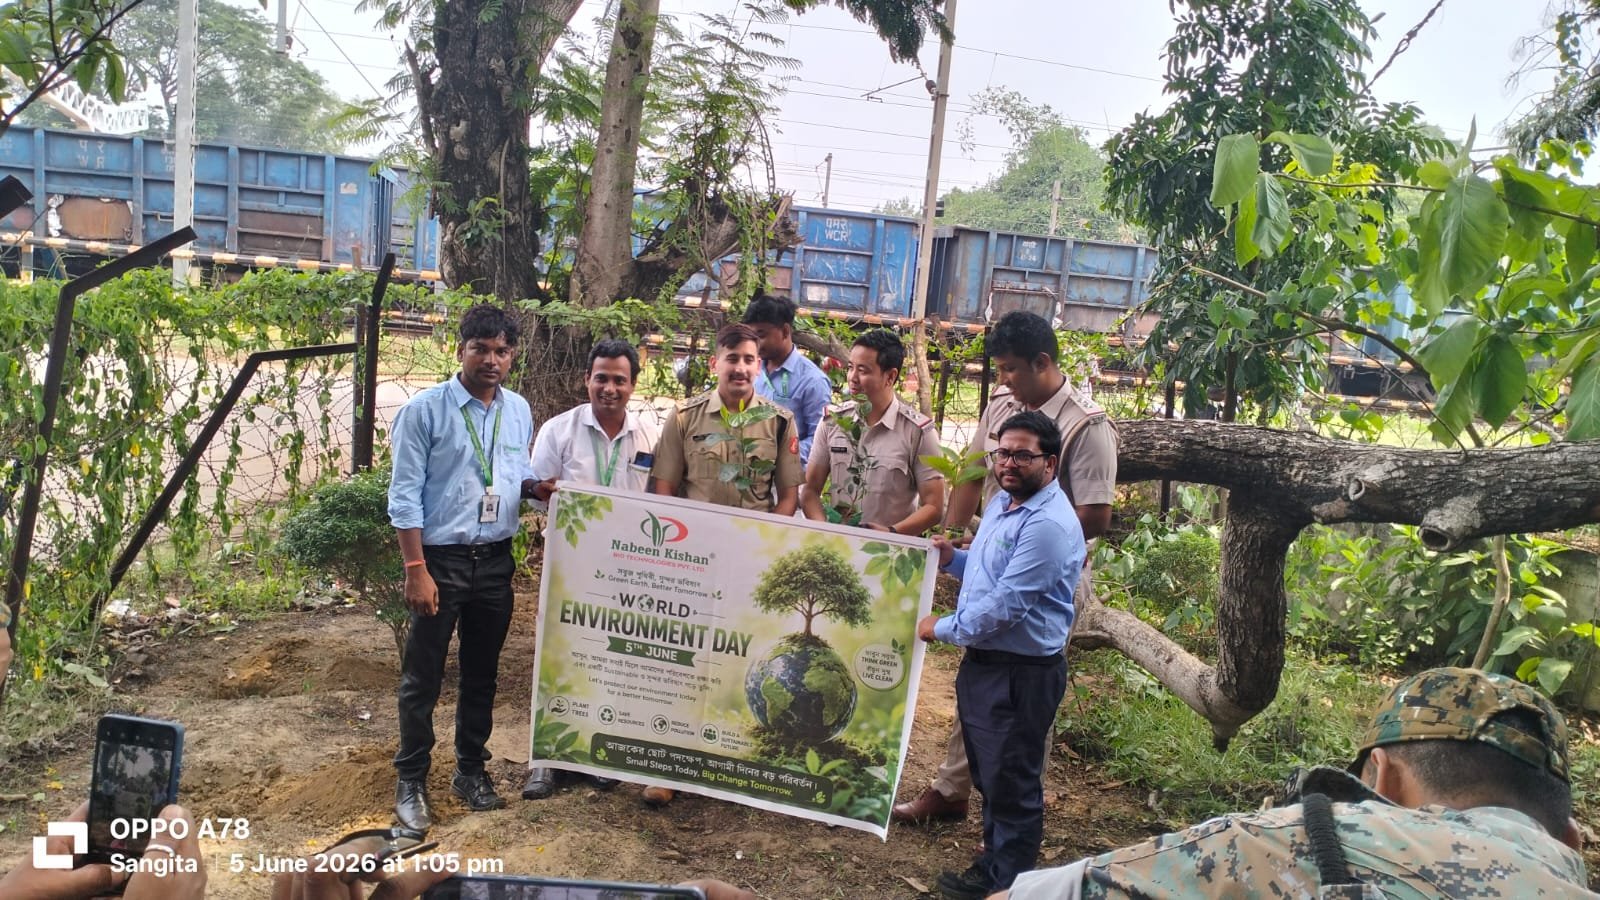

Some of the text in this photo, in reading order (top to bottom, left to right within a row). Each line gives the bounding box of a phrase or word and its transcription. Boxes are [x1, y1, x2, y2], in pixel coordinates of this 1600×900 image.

[825, 229, 848, 241] WCR
[611, 539, 709, 565] Nabeen Kishan
[626, 554, 676, 567] TECHNOLOGIES
[608, 574, 708, 598] Green Earth, Better Tomorrow
[560, 599, 754, 658] ENVIRONMENT DAY
[645, 645, 678, 661] JUNE
[862, 656, 878, 664] THINK
[875, 674, 893, 682] CLEAN
[588, 675, 602, 684] Let's
[603, 680, 626, 690] protect
[639, 686, 678, 698] environment
[679, 693, 697, 703] today
[622, 691, 641, 699] better
[572, 701, 589, 709] PLANT
[571, 709, 589, 718] TREES
[617, 718, 645, 727] RESOURCES
[670, 727, 695, 736] POLLUTION
[721, 730, 736, 738] BUILD
[605, 741, 645, 755] আজকের
[647, 747, 667, 758] ছোট
[707, 759, 735, 773] আগামী
[736, 762, 760, 777] দিনের
[625, 756, 793, 797] Small Steps Today, Big Change Tomorrow.
